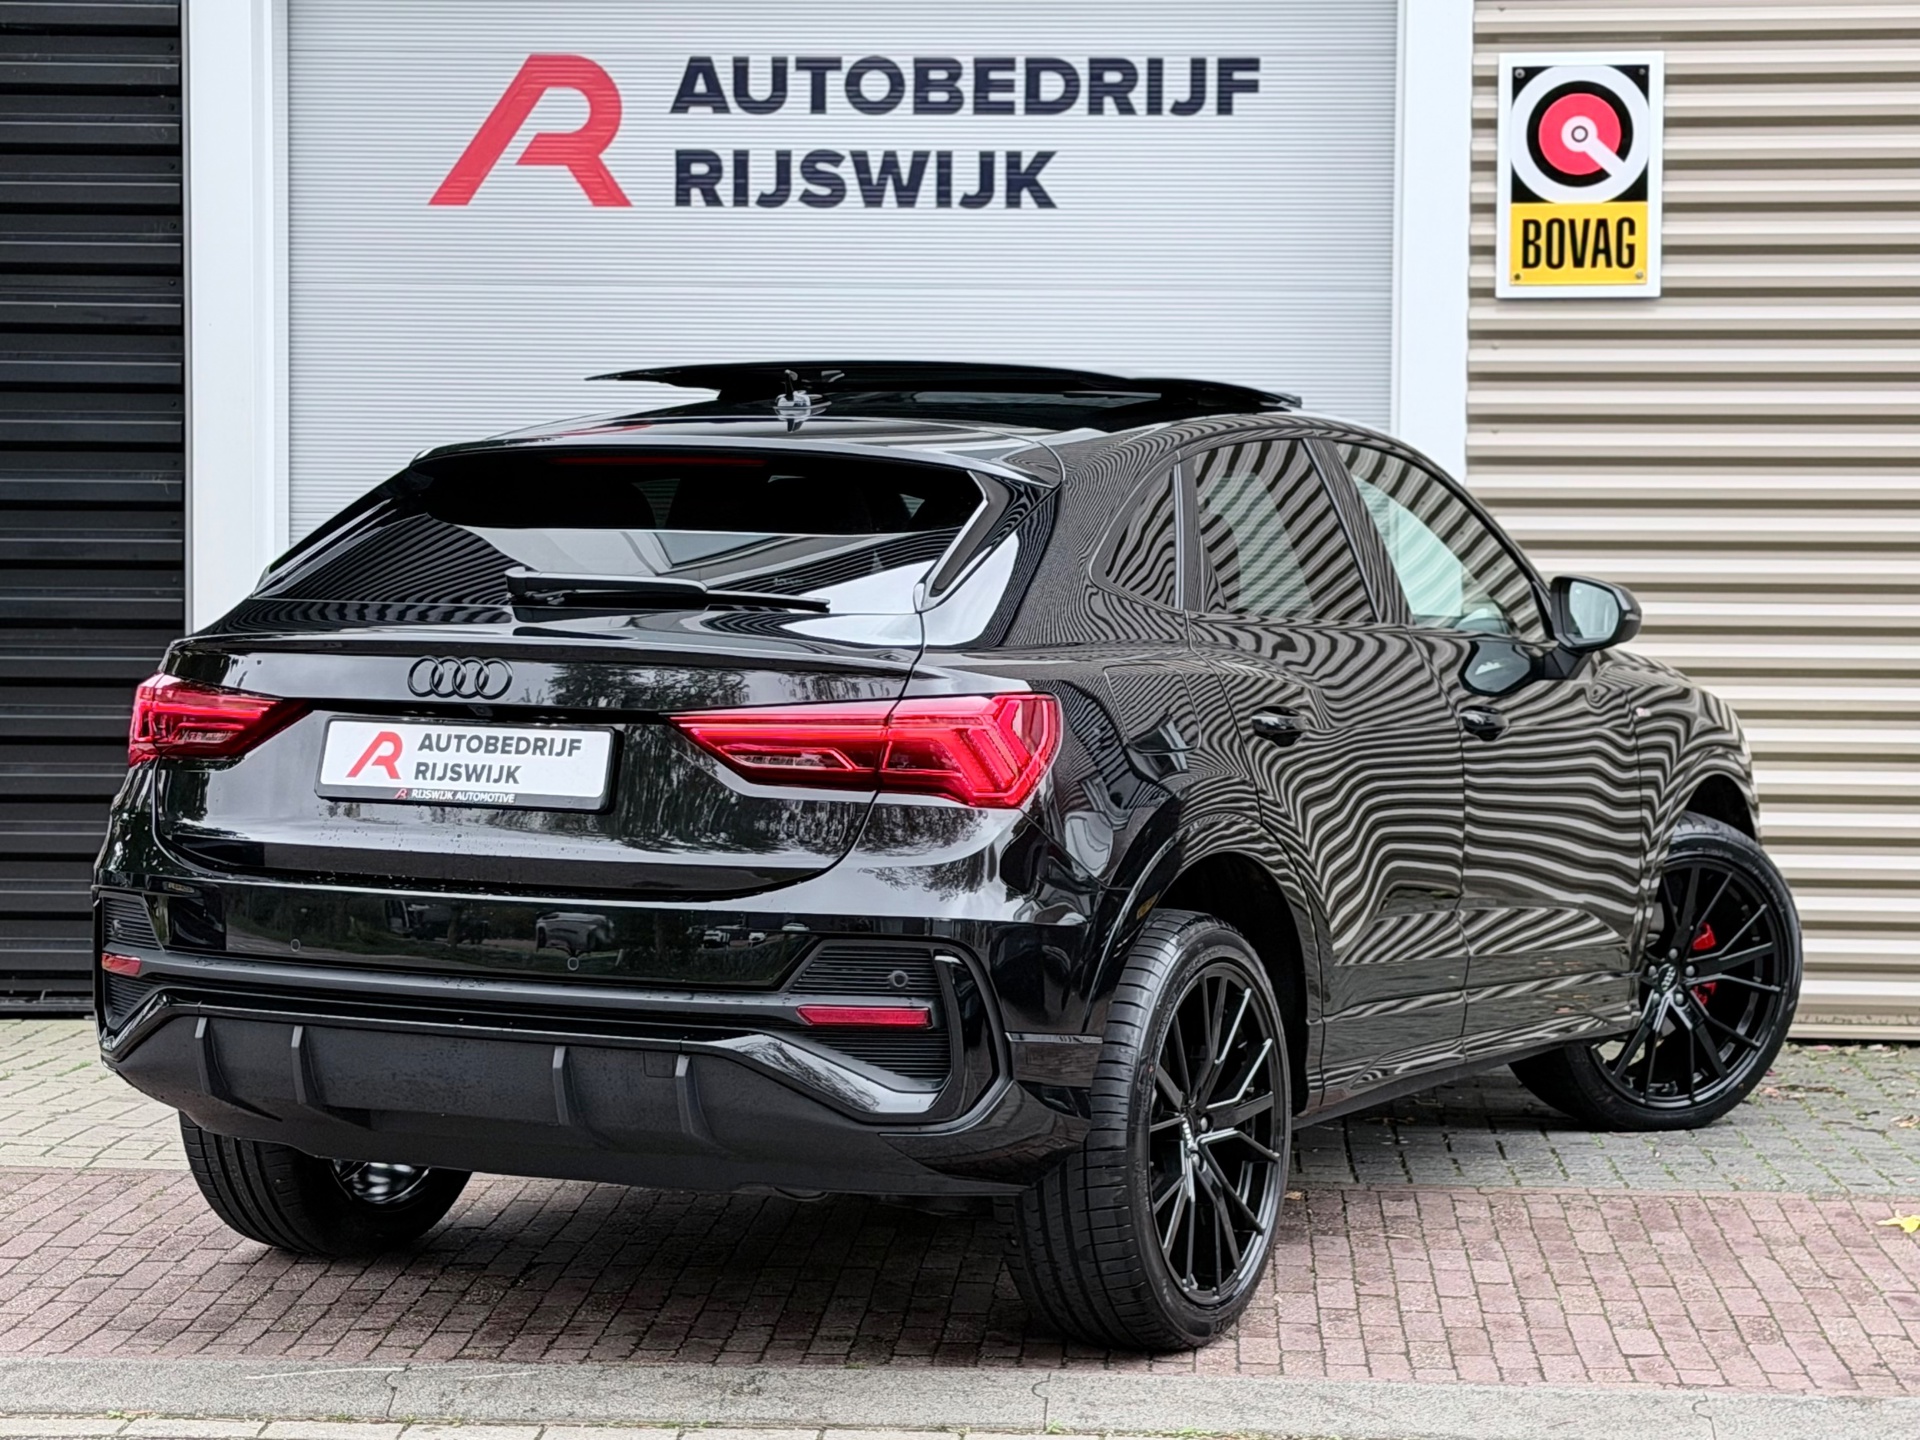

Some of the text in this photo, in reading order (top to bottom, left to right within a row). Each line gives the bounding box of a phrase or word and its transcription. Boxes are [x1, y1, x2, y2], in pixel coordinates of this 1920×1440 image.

[669, 55, 1261, 116] AUTOBEDRIJF
[674, 149, 1058, 210] RIJSWIJK
[1521, 217, 1636, 270] BOVAG
[417, 733, 582, 757] AUTOBEDRIJF
[413, 761, 522, 785] RIJSWIJK
[411, 789, 454, 801] RIJSWIJK
[455, 791, 516, 804] AUTOMOTIVE
